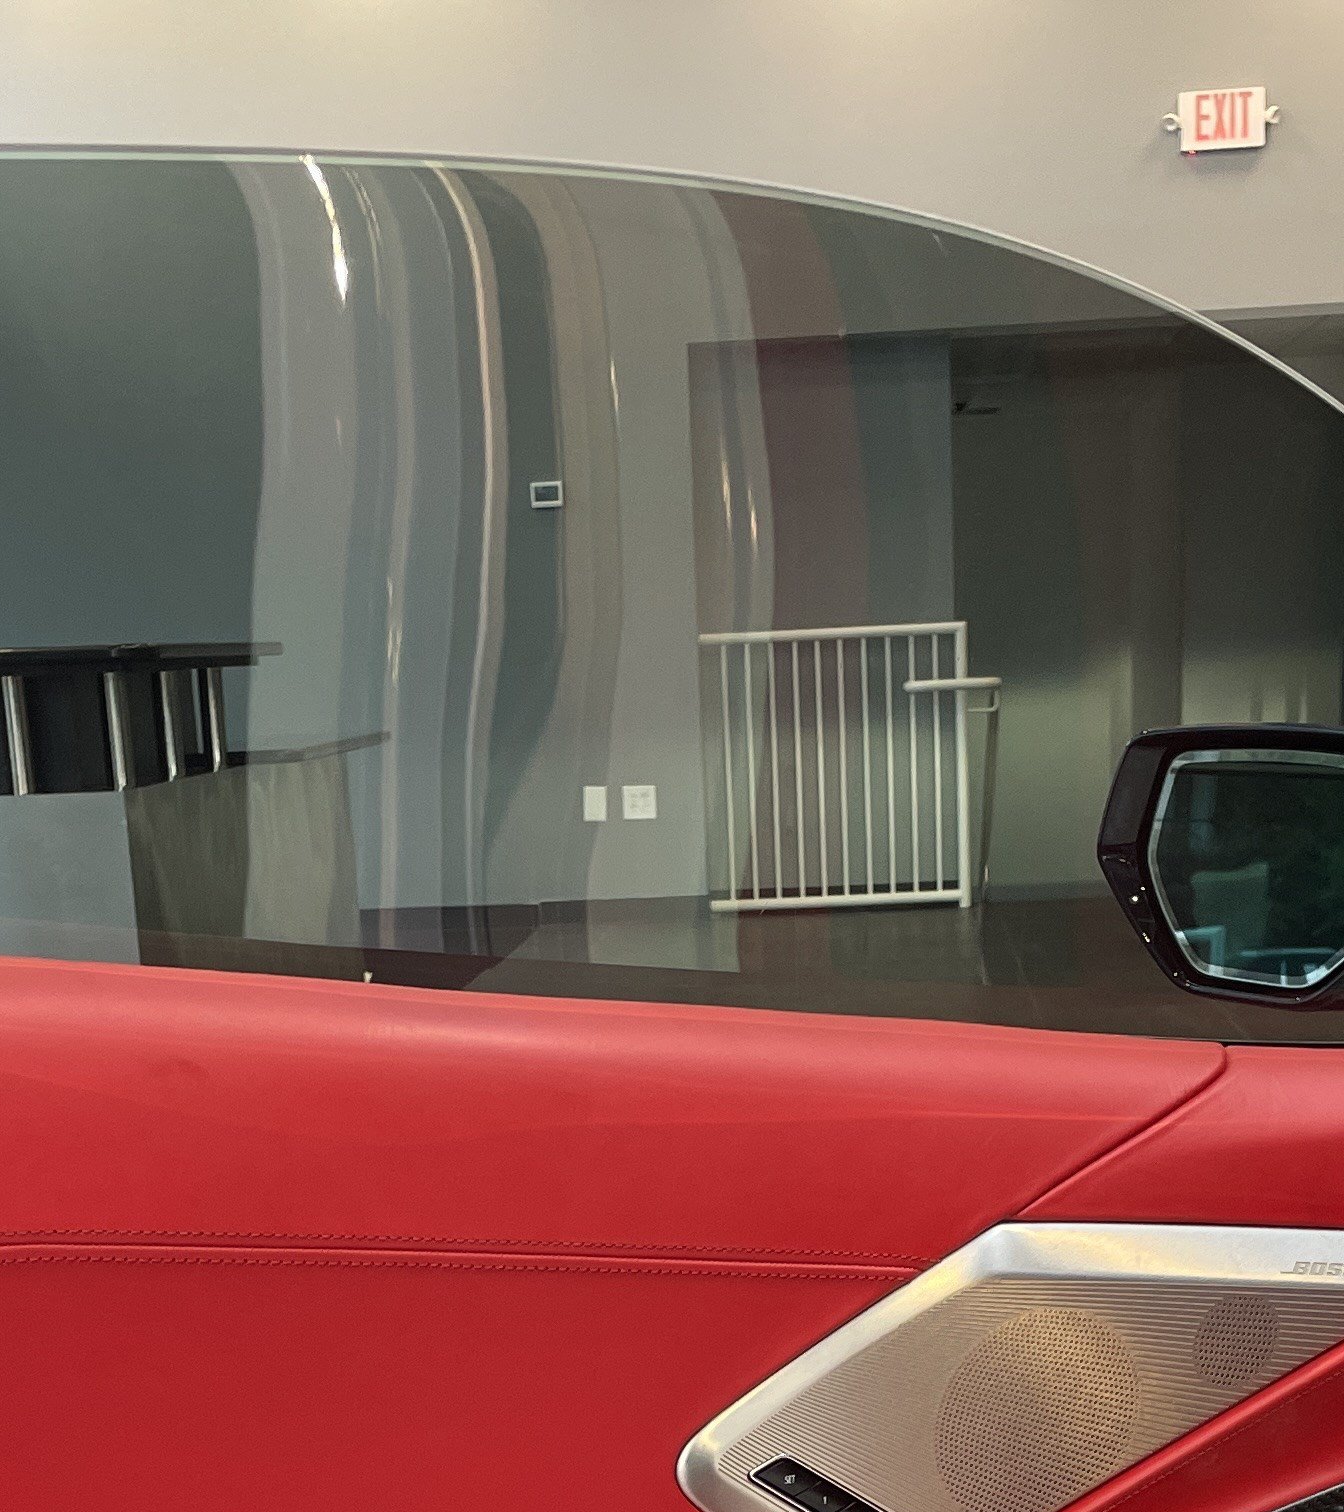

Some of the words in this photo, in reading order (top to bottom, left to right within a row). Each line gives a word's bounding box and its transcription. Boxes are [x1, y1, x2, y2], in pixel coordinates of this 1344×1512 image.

[1195, 91, 1253, 142] EXIT
[784, 1474, 796, 1485] SET
[822, 1496, 827, 1505] 1
